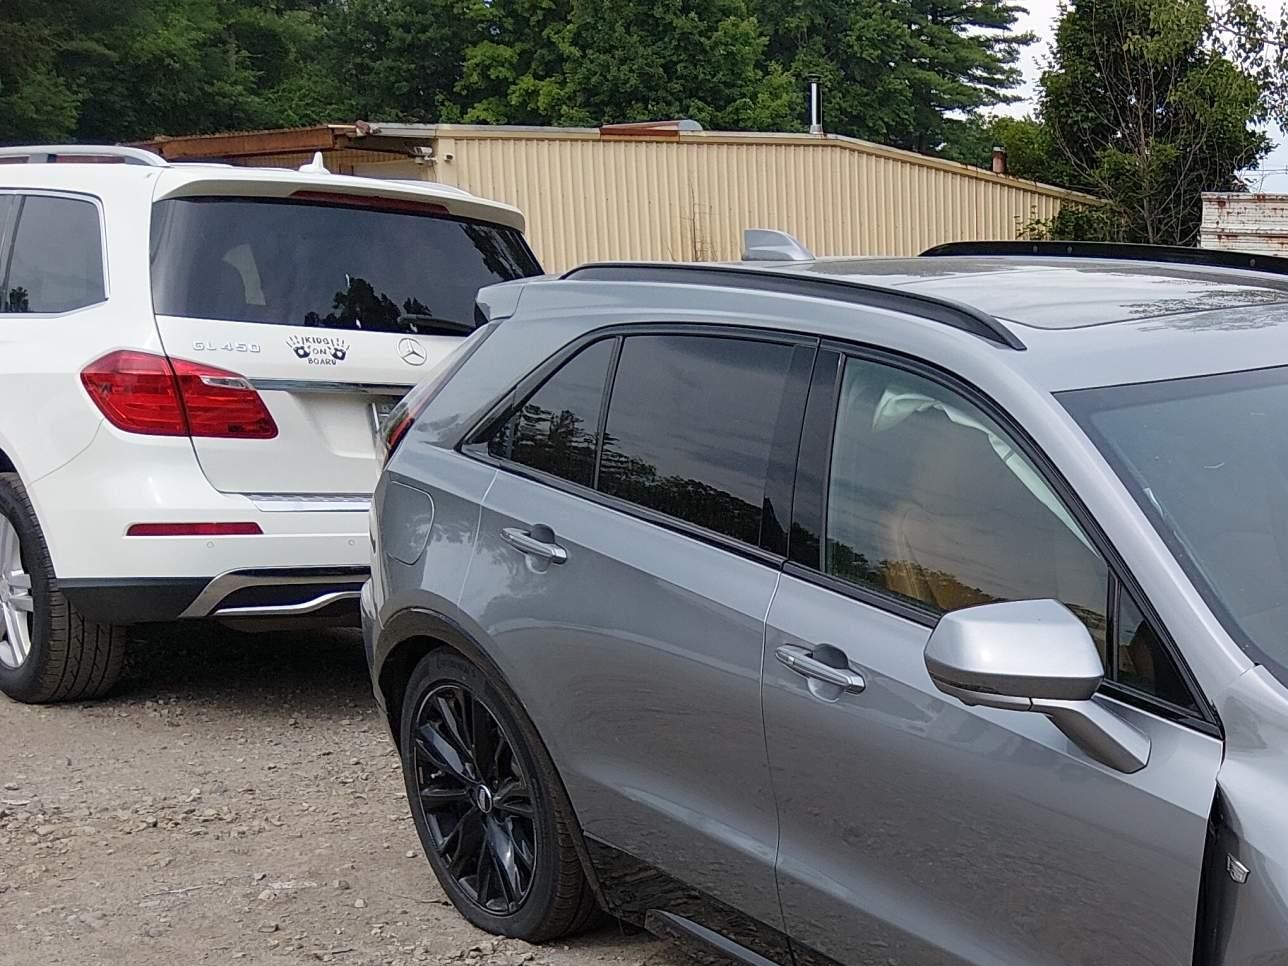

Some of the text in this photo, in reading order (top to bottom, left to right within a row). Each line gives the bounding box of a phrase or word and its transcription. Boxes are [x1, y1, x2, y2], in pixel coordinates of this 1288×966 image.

[192, 340, 261, 353] GL 450
[312, 347, 327, 355] ON
